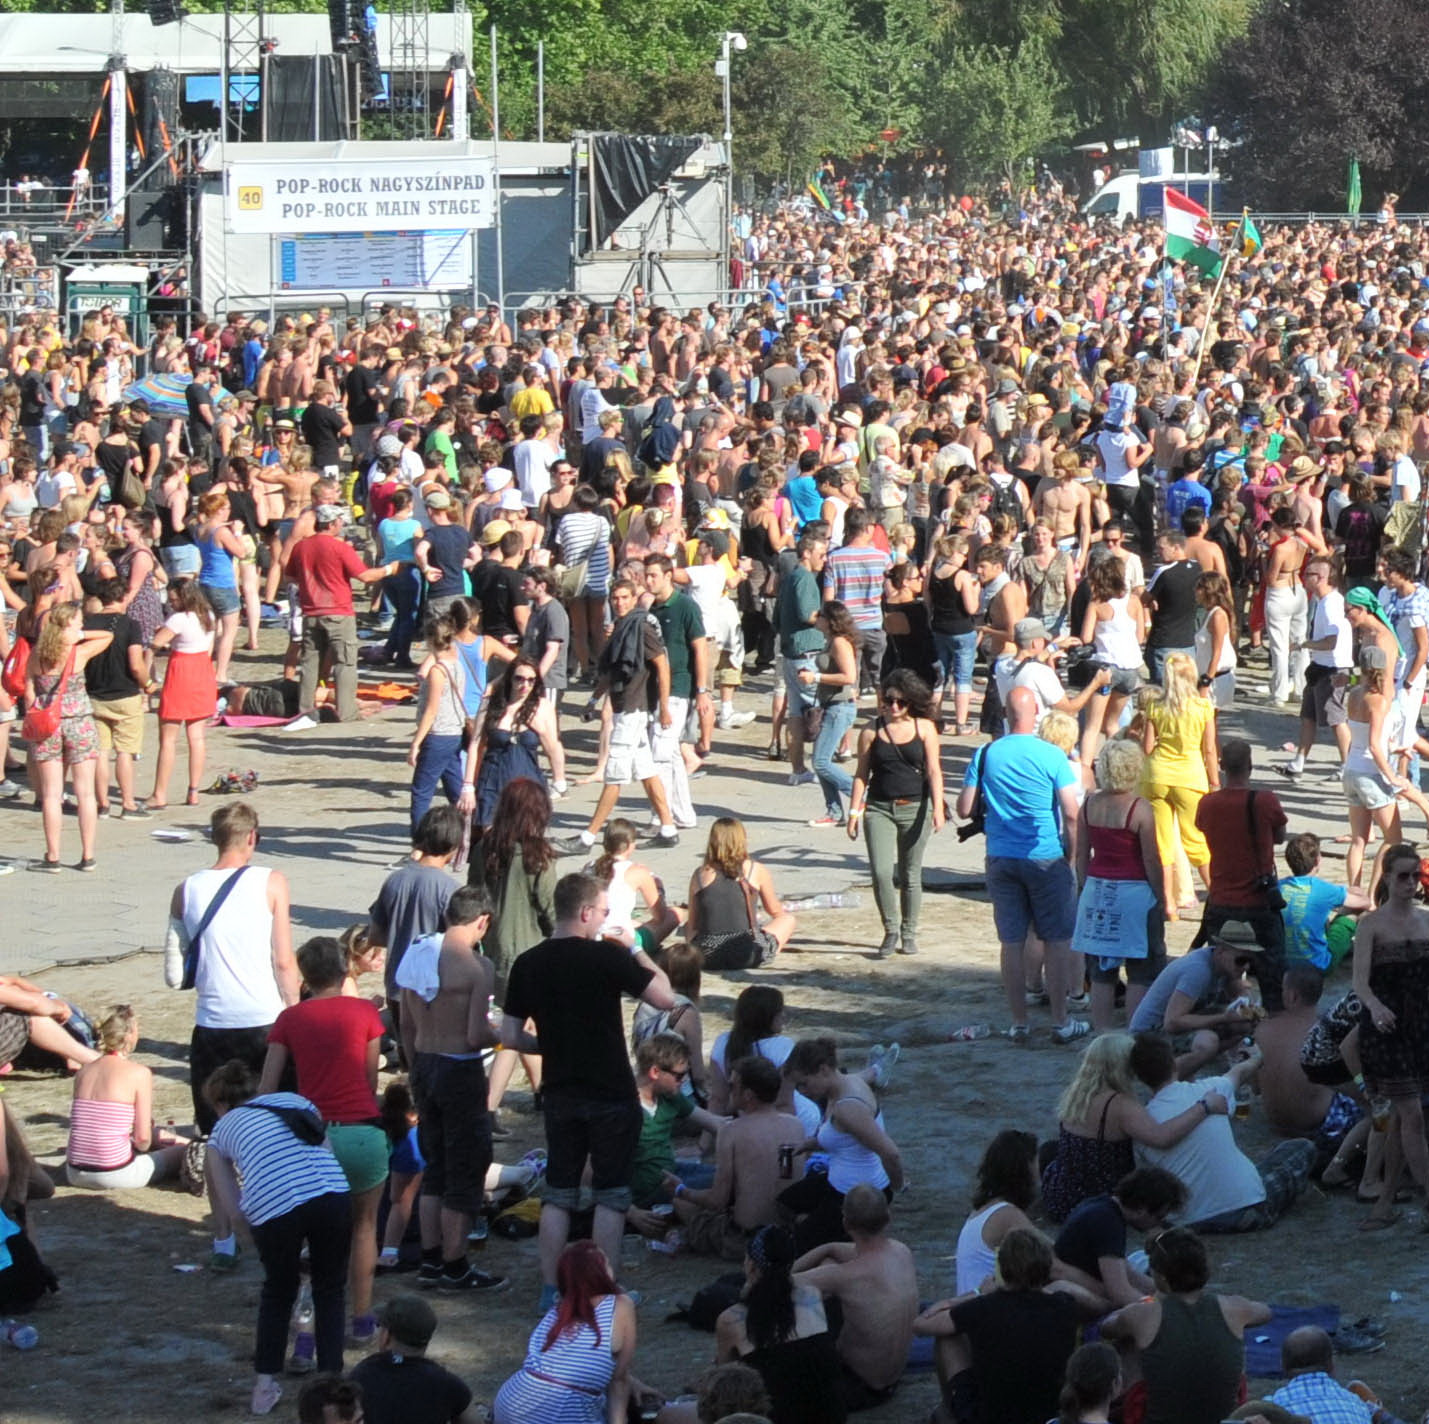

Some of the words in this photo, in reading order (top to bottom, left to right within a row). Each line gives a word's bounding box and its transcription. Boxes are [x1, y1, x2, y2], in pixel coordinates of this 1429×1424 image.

[276, 178, 362, 195] POP-ROCK
[369, 170, 486, 193] NAGYSZÍNPAD
[241, 192, 261, 205] 40
[281, 201, 369, 219] POP-ROCK
[375, 200, 421, 217] MAIN
[427, 198, 481, 216] STAGE
